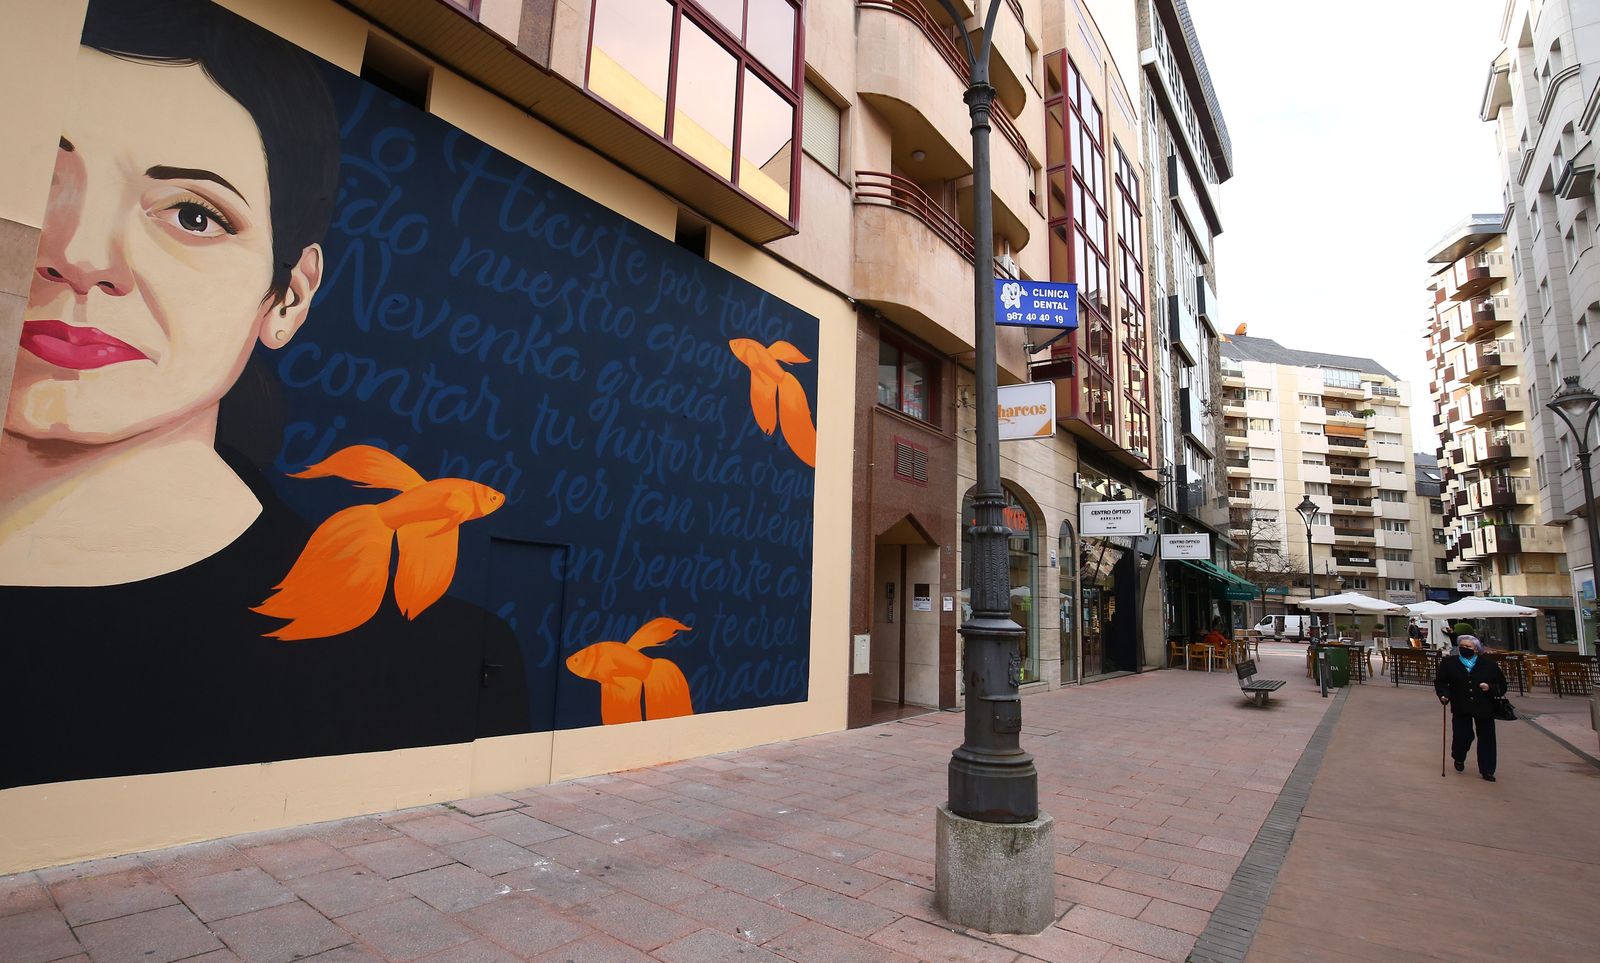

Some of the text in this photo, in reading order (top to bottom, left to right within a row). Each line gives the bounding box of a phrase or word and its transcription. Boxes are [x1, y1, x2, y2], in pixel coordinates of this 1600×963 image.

[450, 237, 636, 338] nuestro
[1006, 311, 1064, 324] 987 40 40 19
[1032, 288, 1069, 299] CLINICA
[1033, 300, 1069, 311] DENTAL
[311, 238, 727, 440] Nevenka gracias
[278, 341, 512, 442] contar
[530, 393, 585, 458] tu
[544, 467, 616, 529] ser
[622, 473, 698, 536] tan
[550, 519, 772, 610] enfrentarte
[689, 655, 809, 713] gracias
